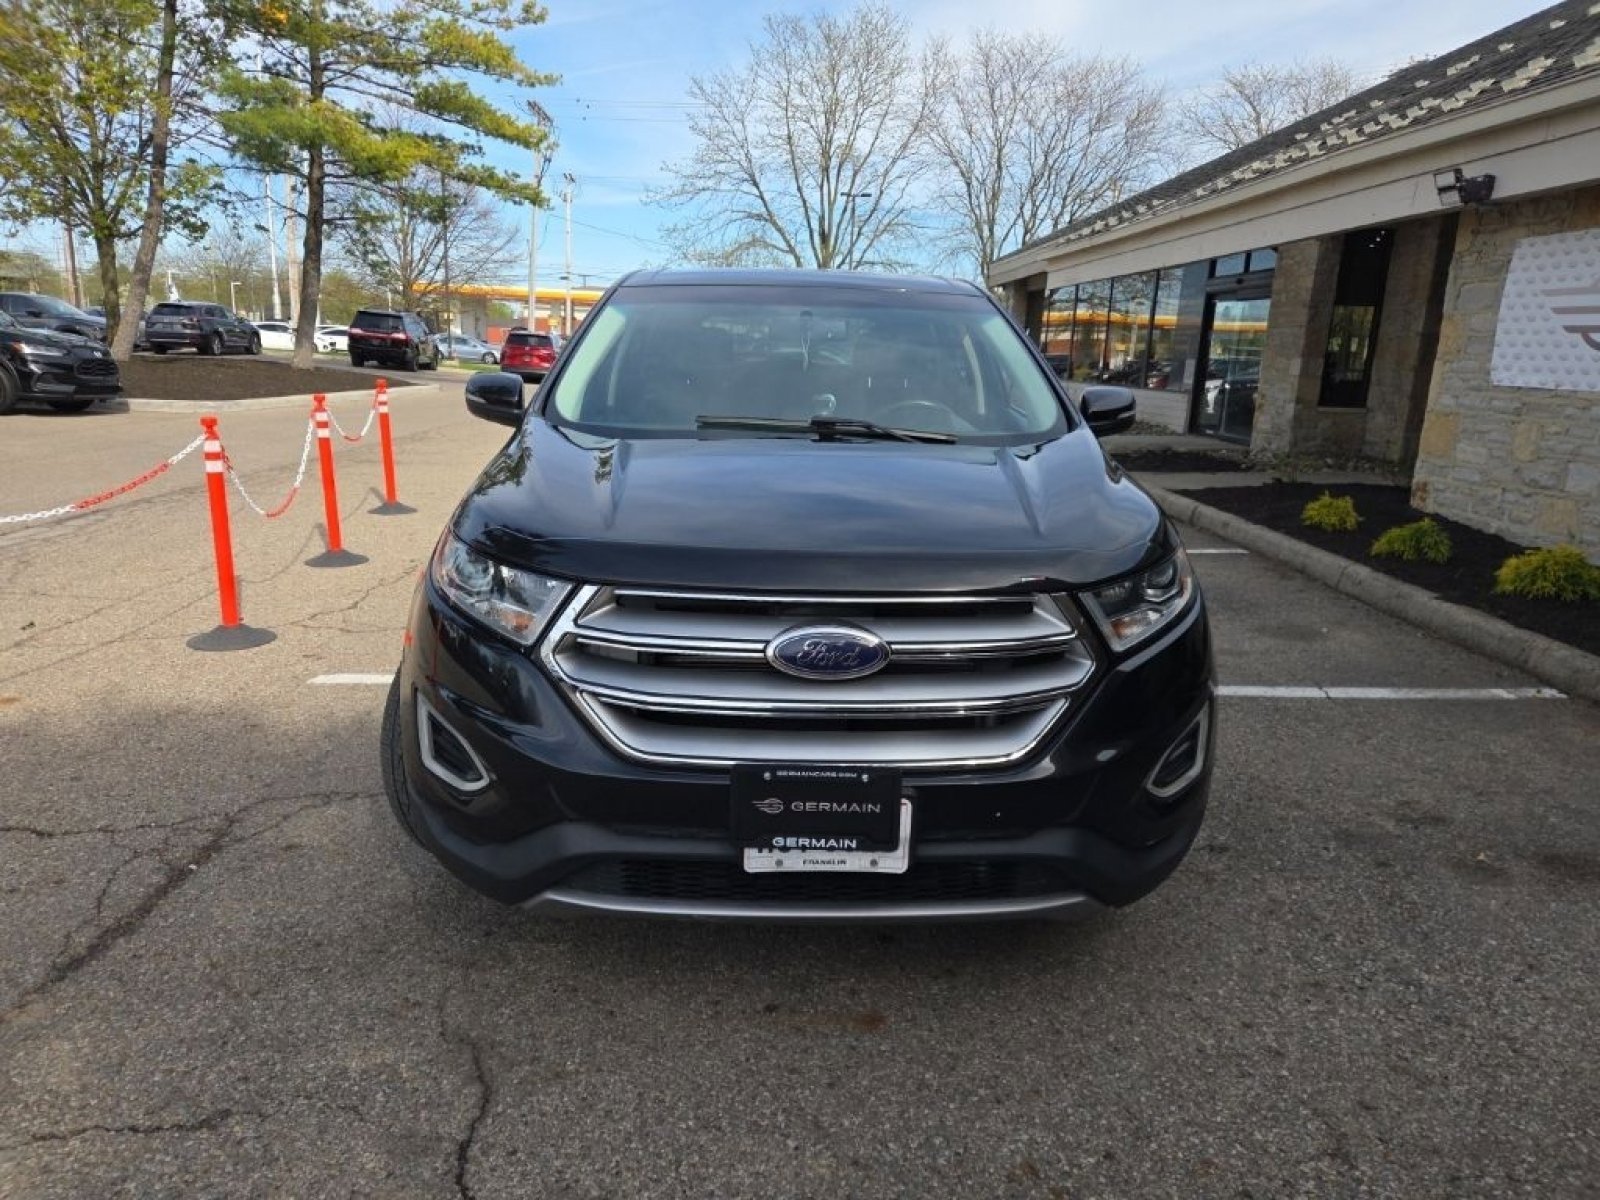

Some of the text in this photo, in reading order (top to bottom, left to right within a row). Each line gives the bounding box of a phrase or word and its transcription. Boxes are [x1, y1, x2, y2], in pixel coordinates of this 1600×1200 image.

[797, 638, 861, 665] Ford
[791, 801, 881, 814] GERMAIN
[772, 836, 857, 849] GERMAIN
[802, 858, 847, 867] FRANKLIN
